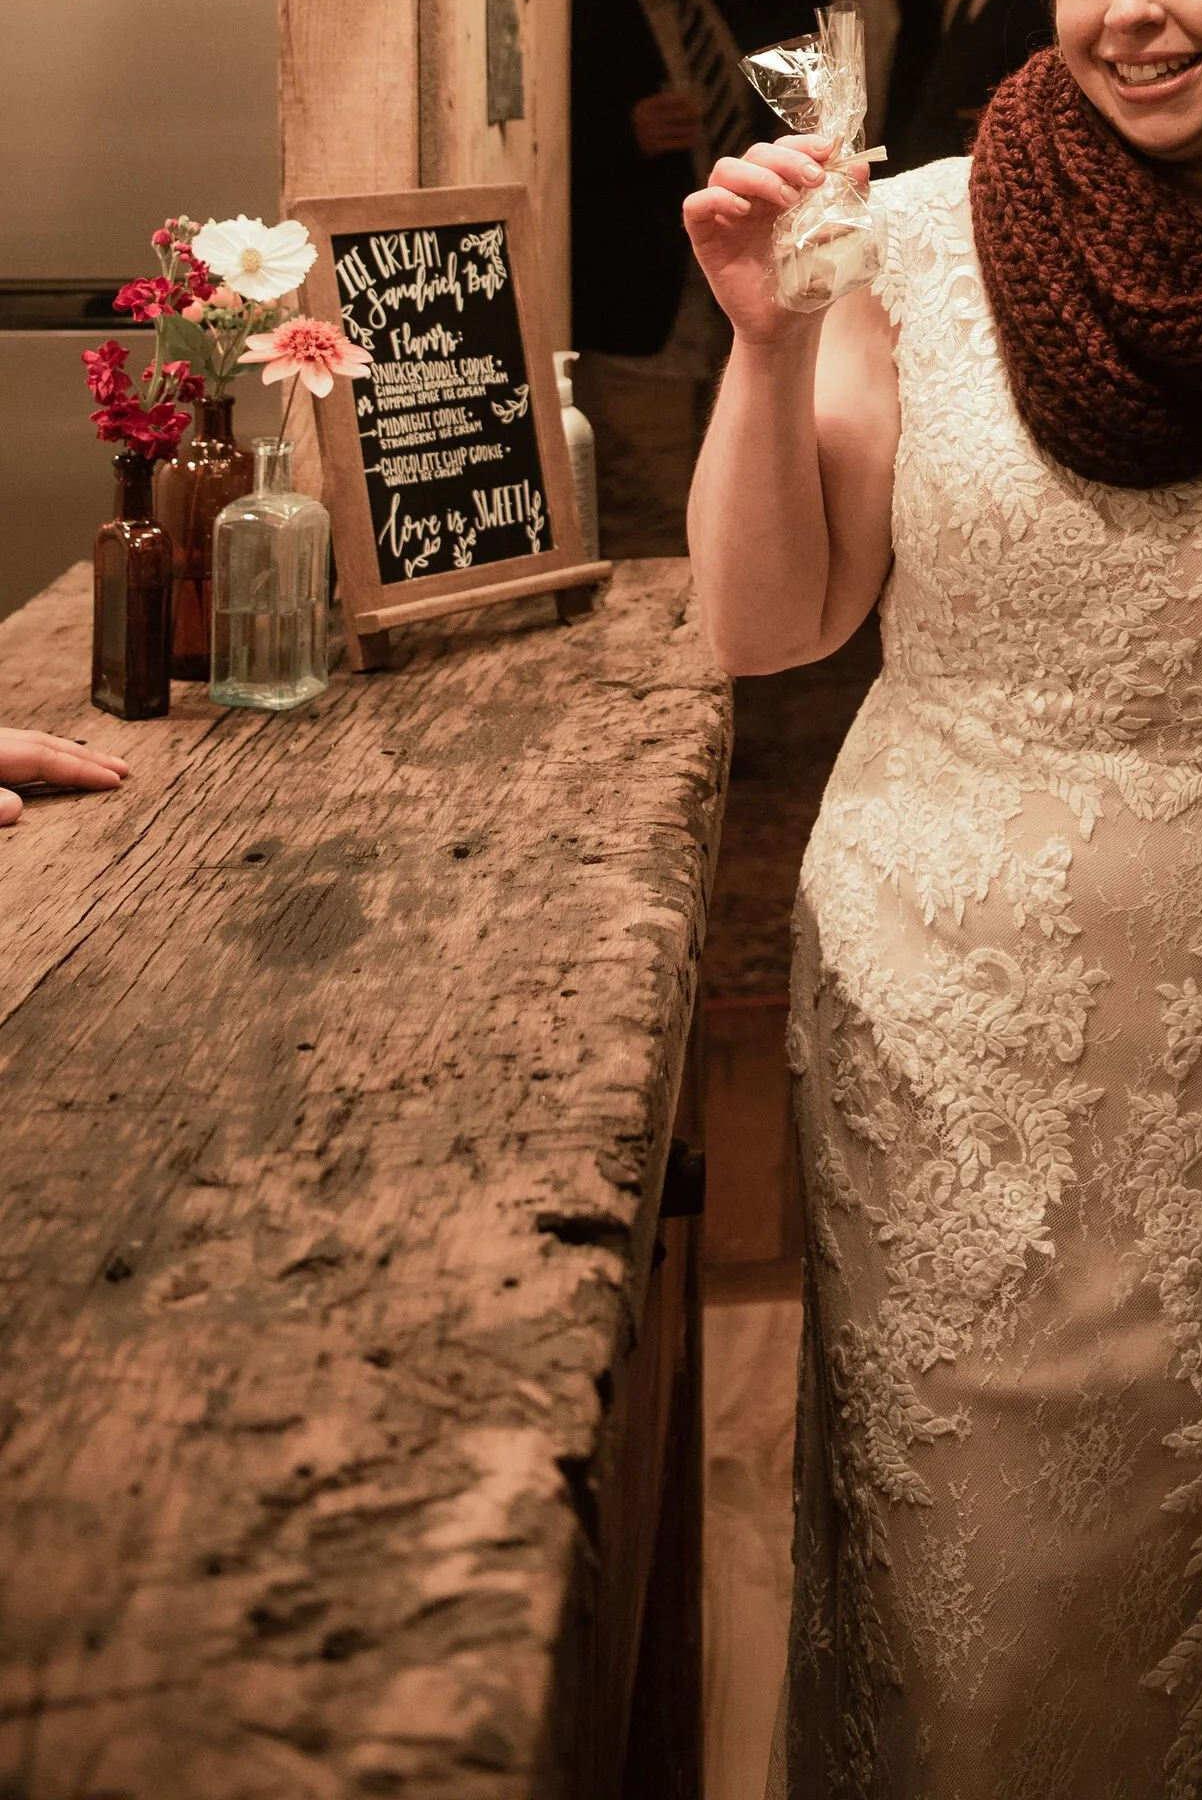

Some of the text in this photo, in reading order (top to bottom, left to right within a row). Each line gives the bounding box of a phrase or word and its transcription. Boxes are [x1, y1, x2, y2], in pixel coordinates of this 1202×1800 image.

[336, 230, 441, 299] ICE CREAM
[366, 251, 504, 329] Sandwich Bar
[371, 359, 459, 385] SNICKERDOODLE
[459, 354, 496, 377] COOKIE
[375, 381, 423, 397] CINNAMON
[480, 371, 509, 385] CREAM
[377, 393, 416, 412] PUMPKIN
[417, 388, 440, 404] SPICE
[442, 387, 456, 400] ICE
[456, 384, 487, 399] CREAM
[377, 411, 432, 438] MIDNIGHT
[432, 406, 467, 430] COOKIE
[380, 419, 483, 450] STRAWBERRY ICE CREAM
[380, 451, 441, 477] CHOCOLATE
[442, 445, 468, 471] CHIP
[469, 443, 504, 465] COOKIE
[384, 472, 418, 488] VANILLA
[434, 464, 463, 479] CREAM
[446, 507, 467, 534] is
[472, 478, 532, 531] SWEET!
